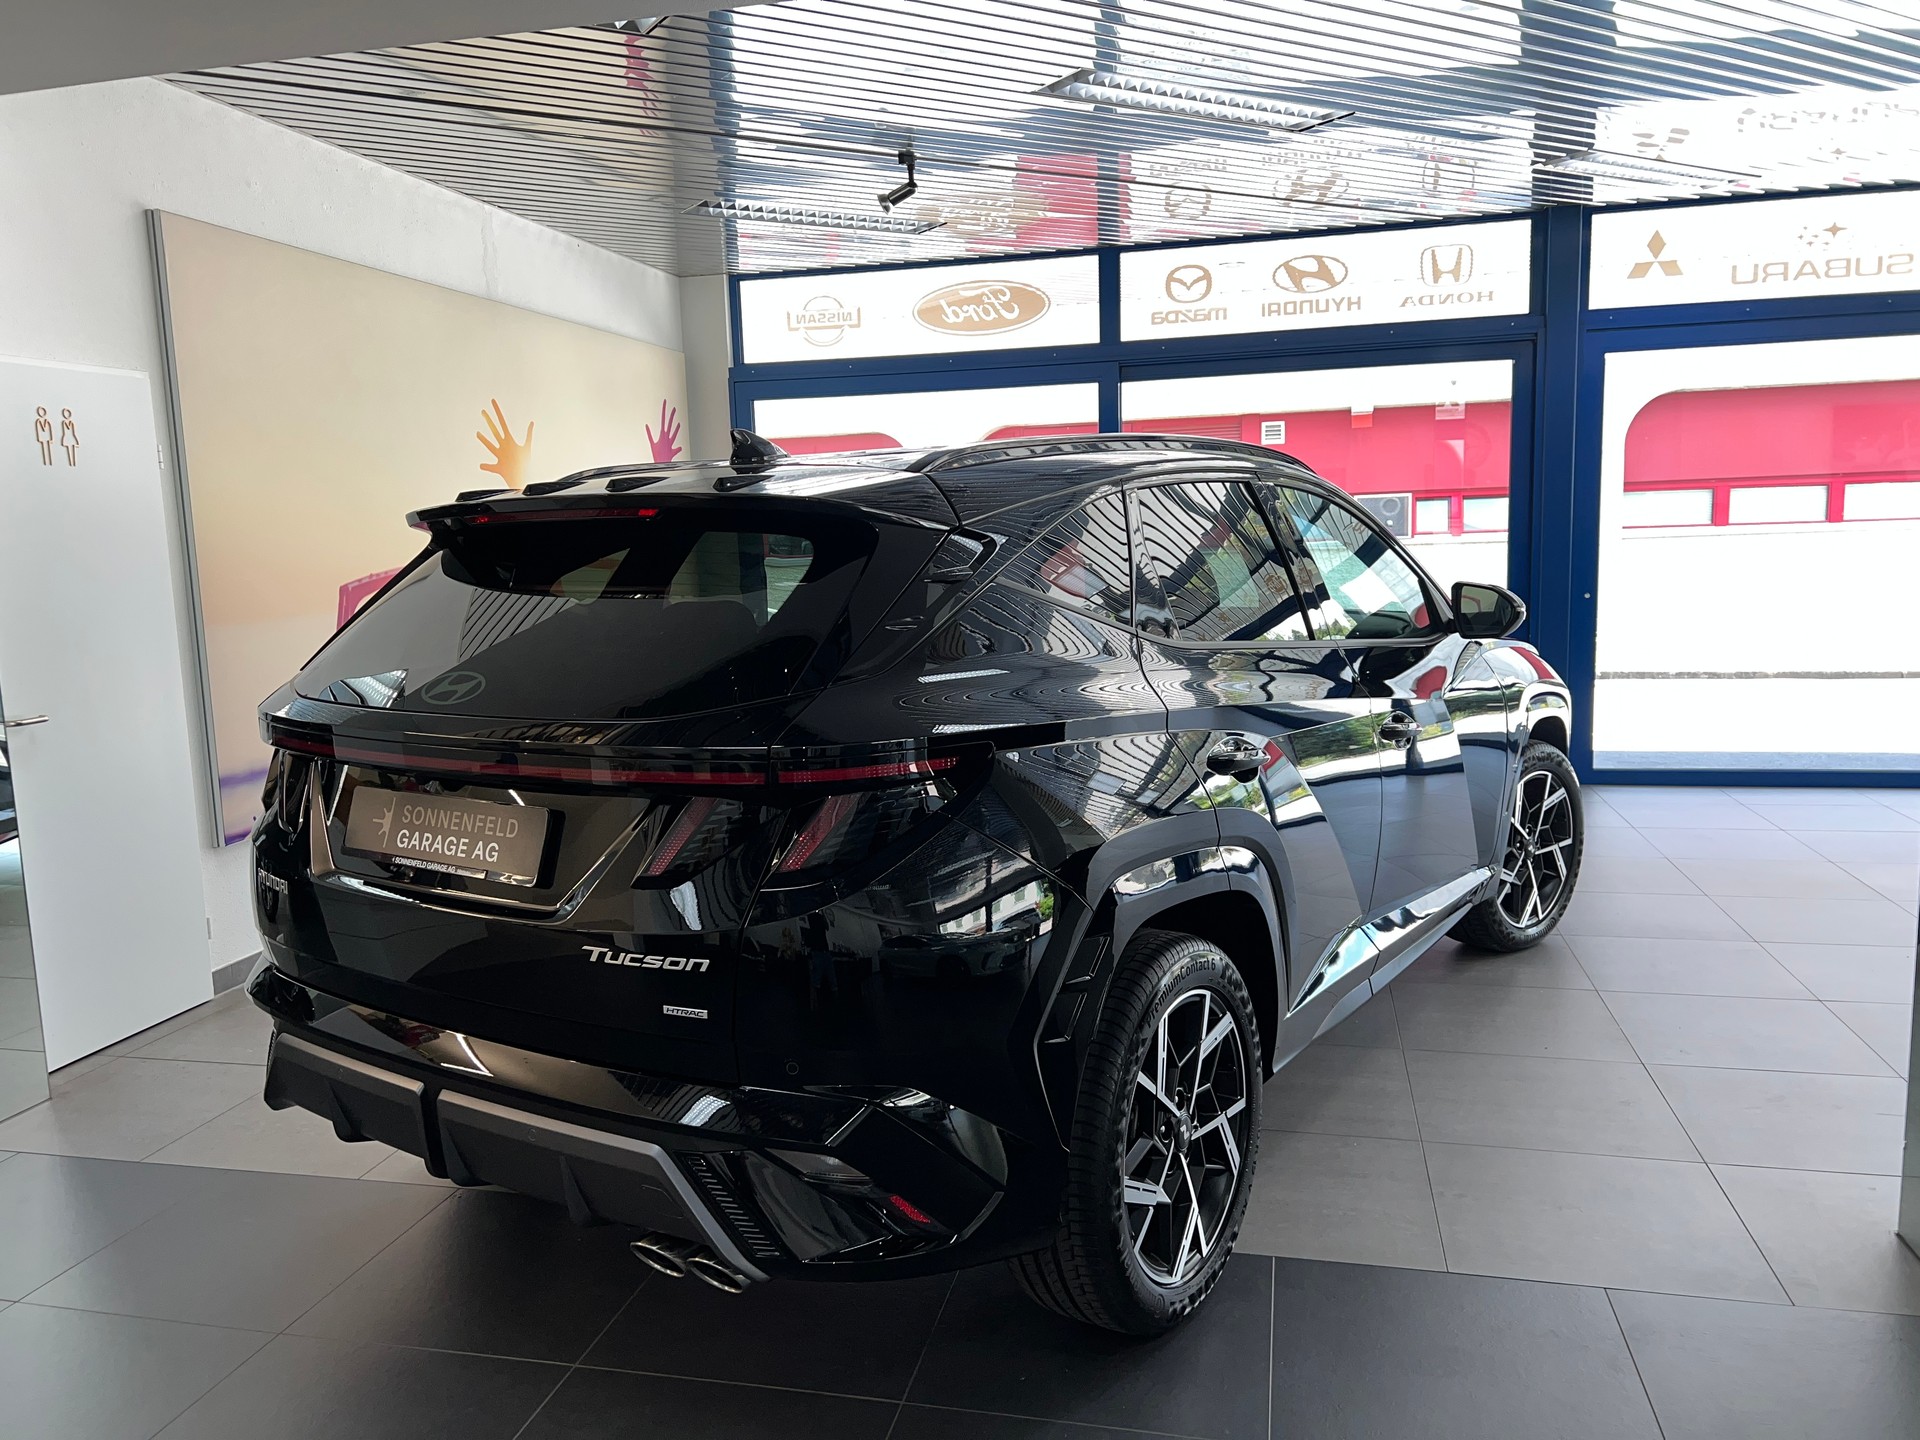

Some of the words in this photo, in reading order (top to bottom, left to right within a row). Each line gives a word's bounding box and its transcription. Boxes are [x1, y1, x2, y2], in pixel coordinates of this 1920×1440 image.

[402, 804, 519, 839] SONNENFELD
[396, 829, 469, 858] GARAGE
[471, 840, 500, 863] AG
[395, 856, 427, 869] SONNENFELD
[426, 863, 447, 872] GARAGE
[1211, 957, 1216, 971] 6
[666, 1007, 705, 1018] HTRAC
